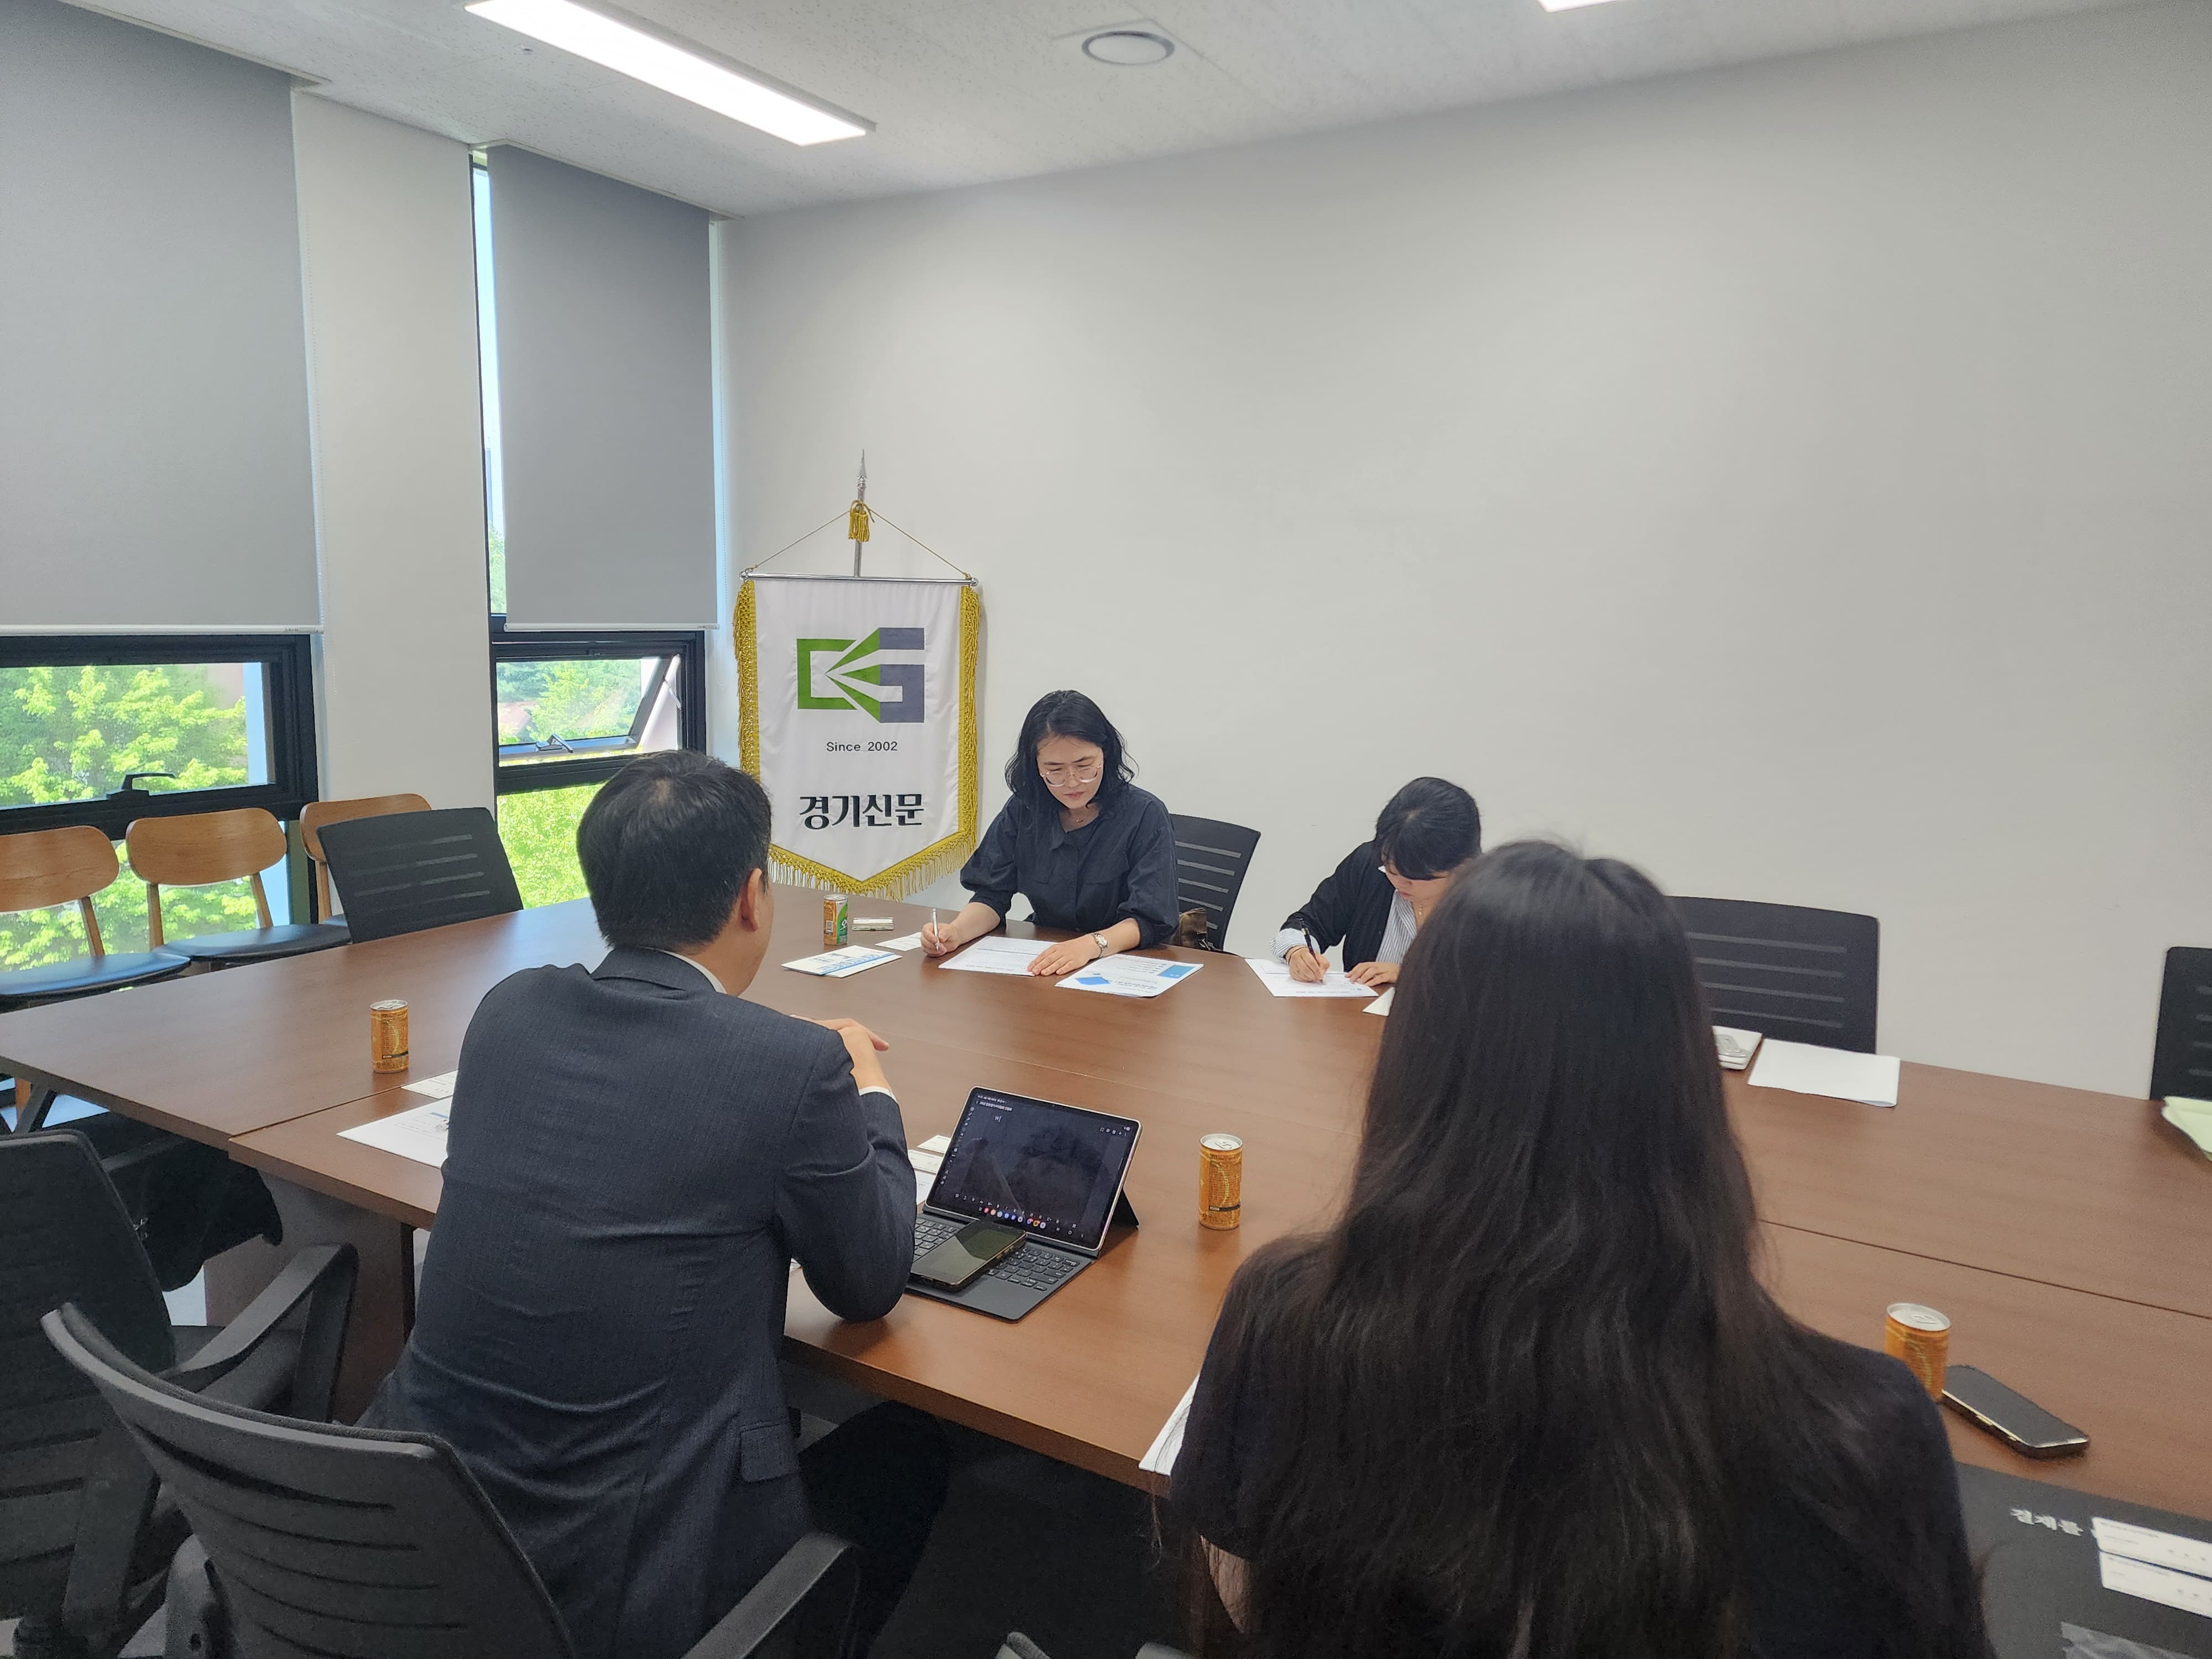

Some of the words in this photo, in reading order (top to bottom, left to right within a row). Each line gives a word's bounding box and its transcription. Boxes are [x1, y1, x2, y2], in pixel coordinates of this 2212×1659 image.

[826, 742, 861, 752] Since
[867, 741, 898, 752] 2002
[799, 794, 925, 830] 경기신문
